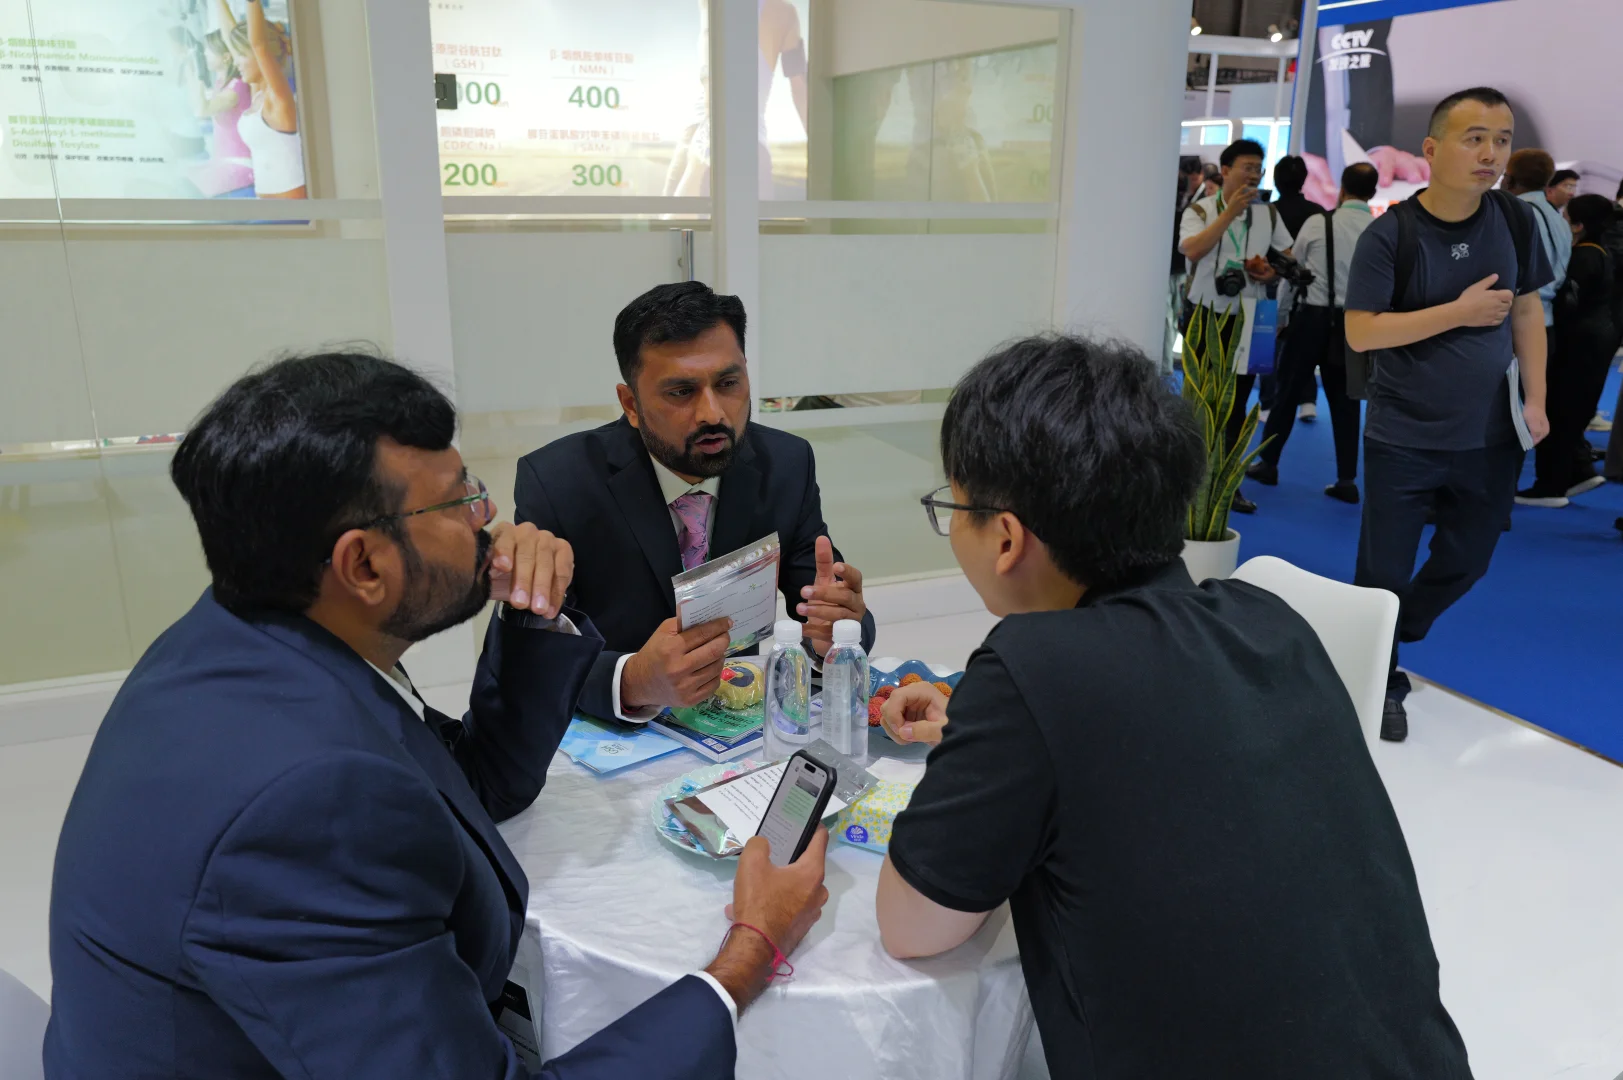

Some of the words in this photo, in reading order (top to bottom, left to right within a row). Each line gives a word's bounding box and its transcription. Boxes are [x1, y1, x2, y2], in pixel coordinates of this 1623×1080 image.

[1331, 28, 1374, 50] CCTV
[433, 43, 502, 58] 原型谷胱甘肽
[568, 86, 620, 108] 400
[443, 163, 498, 186] 200
[572, 164, 622, 187] 300
